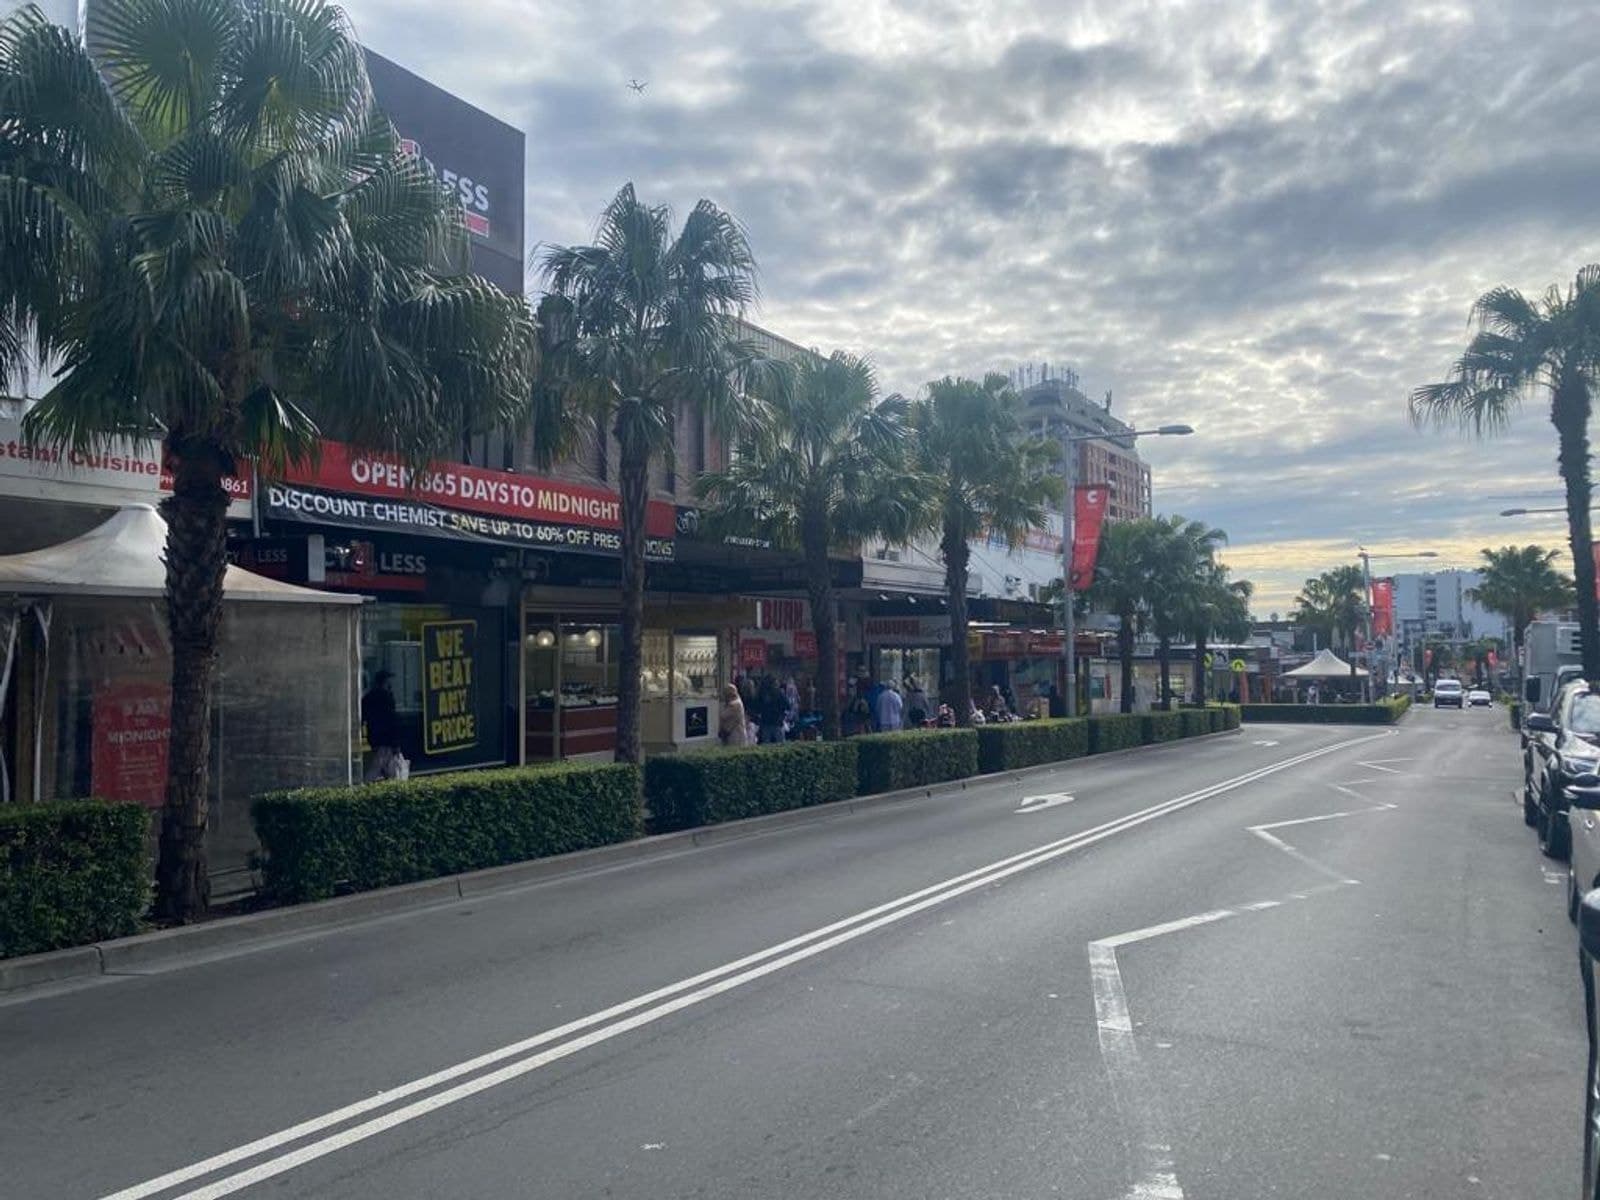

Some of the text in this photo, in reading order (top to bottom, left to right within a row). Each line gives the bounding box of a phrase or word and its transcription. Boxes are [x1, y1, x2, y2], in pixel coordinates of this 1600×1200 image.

[69, 447, 160, 475] Cuisine
[351, 458, 416, 491] OPEN
[460, 476, 509, 505] DAYS
[512, 486, 535, 508] TO
[537, 490, 621, 521] MIDNIGHT
[268, 487, 370, 518] DISCOUNT
[373, 502, 447, 528] CHEMIST
[451, 511, 490, 535] SAVE
[491, 521, 511, 536] UP
[513, 522, 534, 539] TO
[536, 526, 564, 543] 60%
[567, 529, 591, 545] OFF
[380, 551, 427, 574] LESS
[435, 629, 464, 659] WE
[429, 657, 473, 690] BEAT
[438, 689, 468, 717] ANY
[430, 714, 476, 745] PRICE
